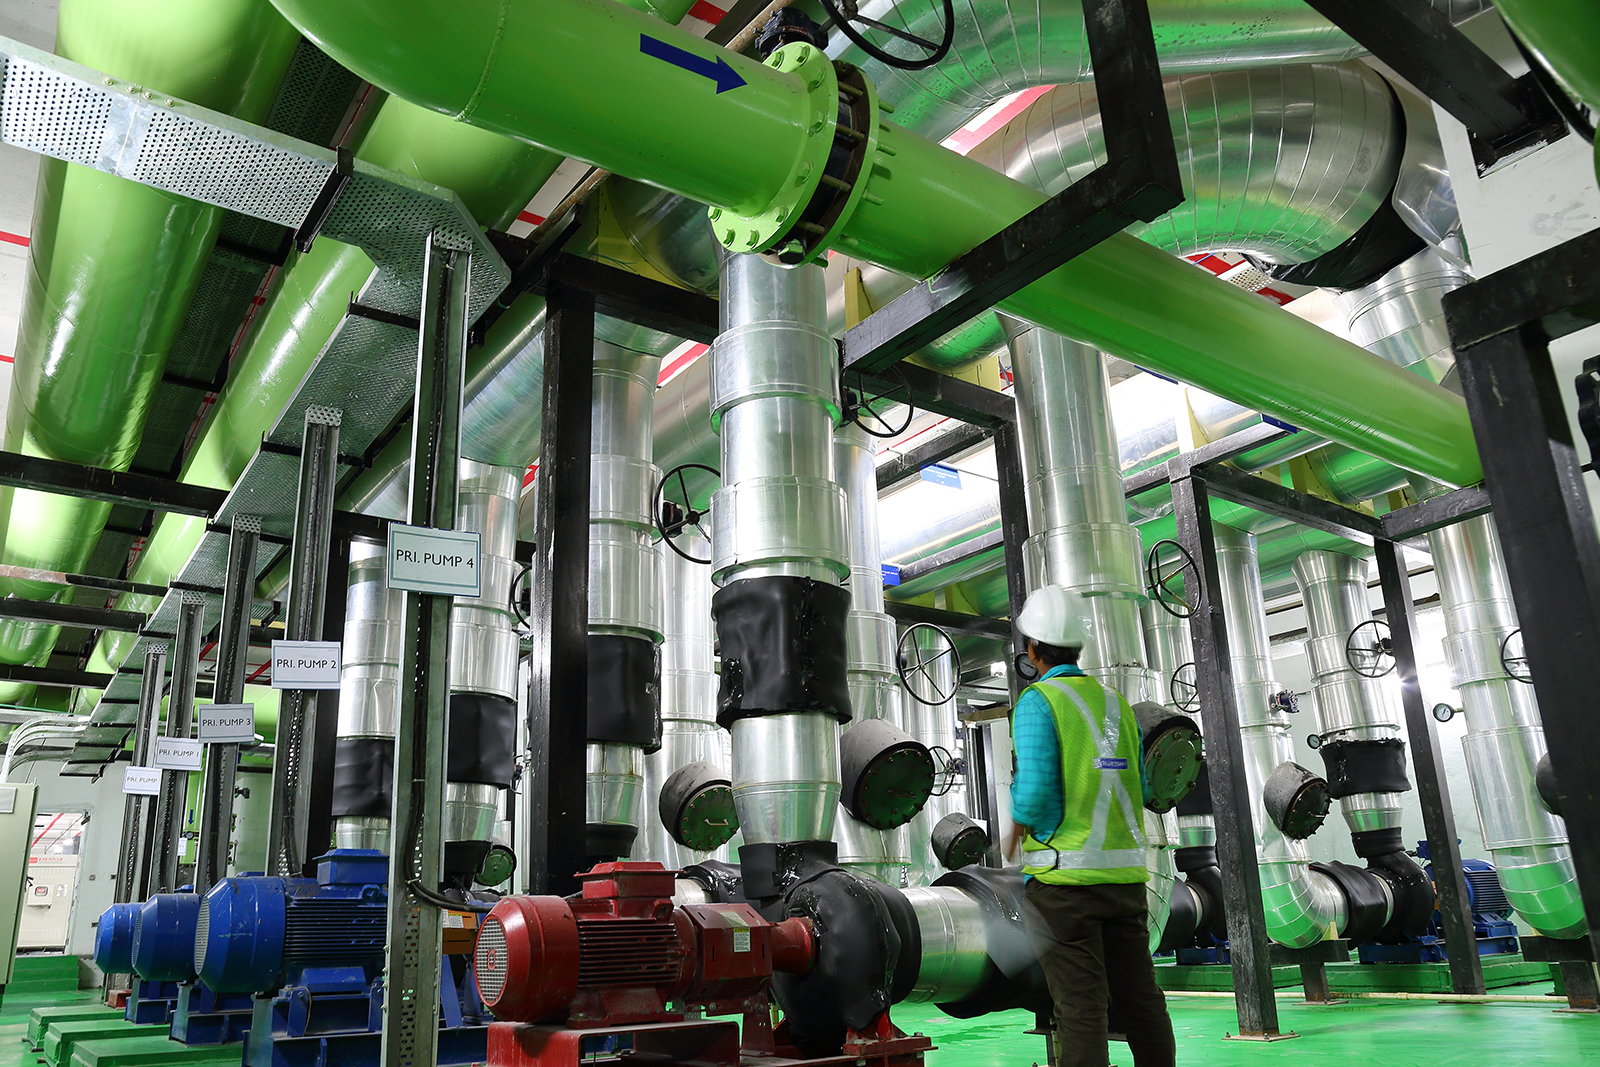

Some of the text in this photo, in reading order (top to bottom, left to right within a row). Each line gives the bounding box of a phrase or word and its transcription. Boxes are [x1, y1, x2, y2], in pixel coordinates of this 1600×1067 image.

[396, 549, 474, 569] PRI. PUMP 4
[276, 658, 337, 669] PRI. PUMP 2
[202, 717, 251, 727] PRI. PUMP 3
[158, 748, 172, 756] PRI.
[172, 749, 194, 757] PUMP
